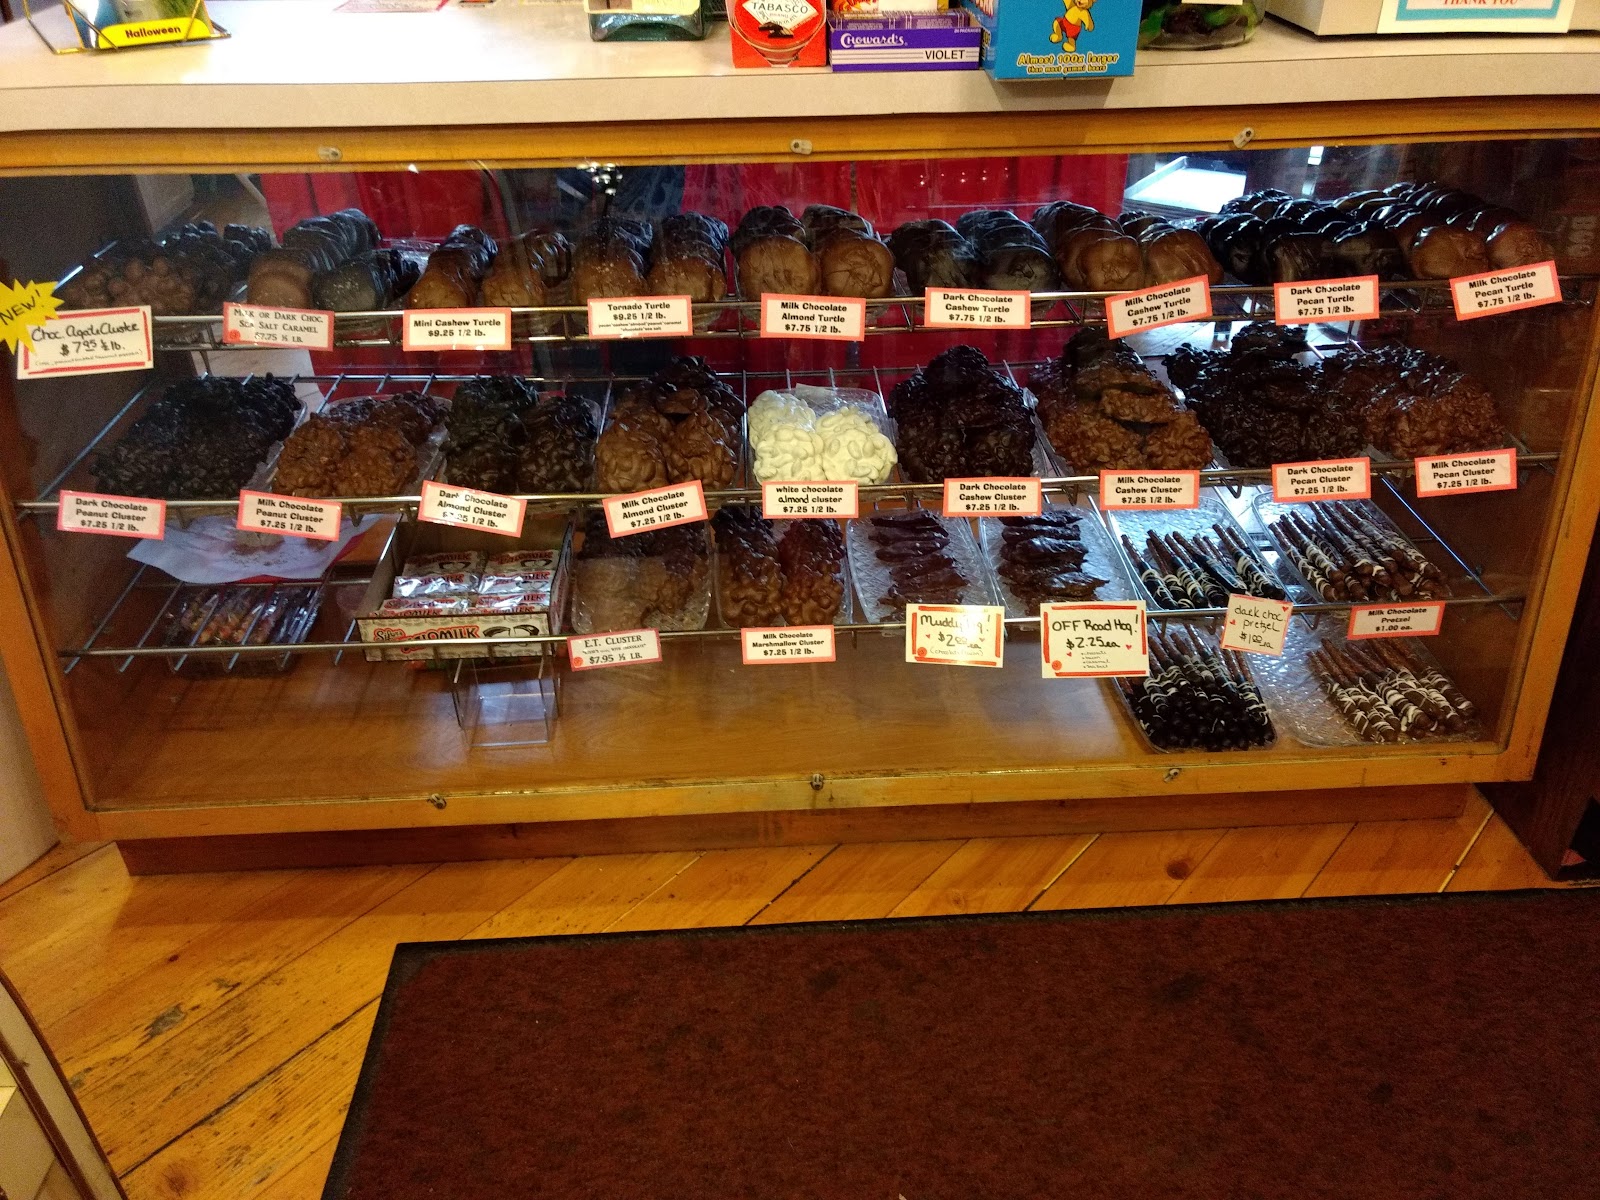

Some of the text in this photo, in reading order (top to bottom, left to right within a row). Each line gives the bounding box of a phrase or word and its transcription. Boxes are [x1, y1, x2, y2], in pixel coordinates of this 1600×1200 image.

[753, 3, 808, 14] TABASCO
[125, 25, 182, 39] Halloween
[925, 50, 965, 60] VIOLET
[1017, 53, 1119, 65] Almost 100x larger
[1469, 270, 1536, 289] Milk Chocolate
[1291, 284, 1361, 295] Dark Chocolate
[1475, 282, 1533, 298] Pecan Turtle
[943, 293, 1013, 302] Dark Chocolate
[1125, 287, 1191, 307] Milk Chocolate
[1327, 295, 1354, 303] Turtle
[1478, 298, 1504, 308] $7.75
[1508, 294, 1520, 303] 1/2
[0, 289, 45, 326] NEW!
[608, 302, 670, 311] Tornado Turtle
[803, 303, 847, 311] Chocolate
[1127, 297, 1191, 316] Cashew Turtle
[1298, 307, 1323, 316] $7.75
[1327, 306, 1340, 314] 1/2
[782, 313, 845, 322] Almond Turtle
[949, 314, 975, 322] $7.75
[1132, 315, 1158, 326] $7.75
[1162, 311, 1174, 320] 1/2
[428, 329, 454, 337] $9.25
[785, 324, 810, 332] $7.75
[815, 325, 827, 333] 1/2
[1452, 458, 1496, 467] Chocolate
[1311, 465, 1353, 473] Chocolate
[1463, 468, 1495, 477] Cluster
[1437, 480, 1462, 489] $7.25
[76, 498, 148, 511] Dark Chocolate
[465, 494, 508, 509] Chocolate
[621, 491, 684, 509] Milk Chocolate
[778, 494, 809, 503] almond
[258, 498, 324, 513] Milk Chocolate
[437, 500, 506, 519] Almond Cluster
[622, 501, 688, 519] Almond Cluster
[76, 509, 146, 522] Peanut Cluster
[256, 509, 323, 523] Peanut Cluster
[631, 517, 655, 528] $7.25
[659, 514, 671, 522] 1/2
[80, 520, 139, 532] $7.25 1/2 lb.
[260, 519, 316, 533] $7.25 1/2 lb.
[472, 517, 498, 528] 1/2 lb.
[1234, 605, 1260, 618] dark
[1052, 614, 1138, 635] OFF Road Hog!
[1243, 619, 1280, 633] pretzel
[589, 654, 614, 664] $7.95
